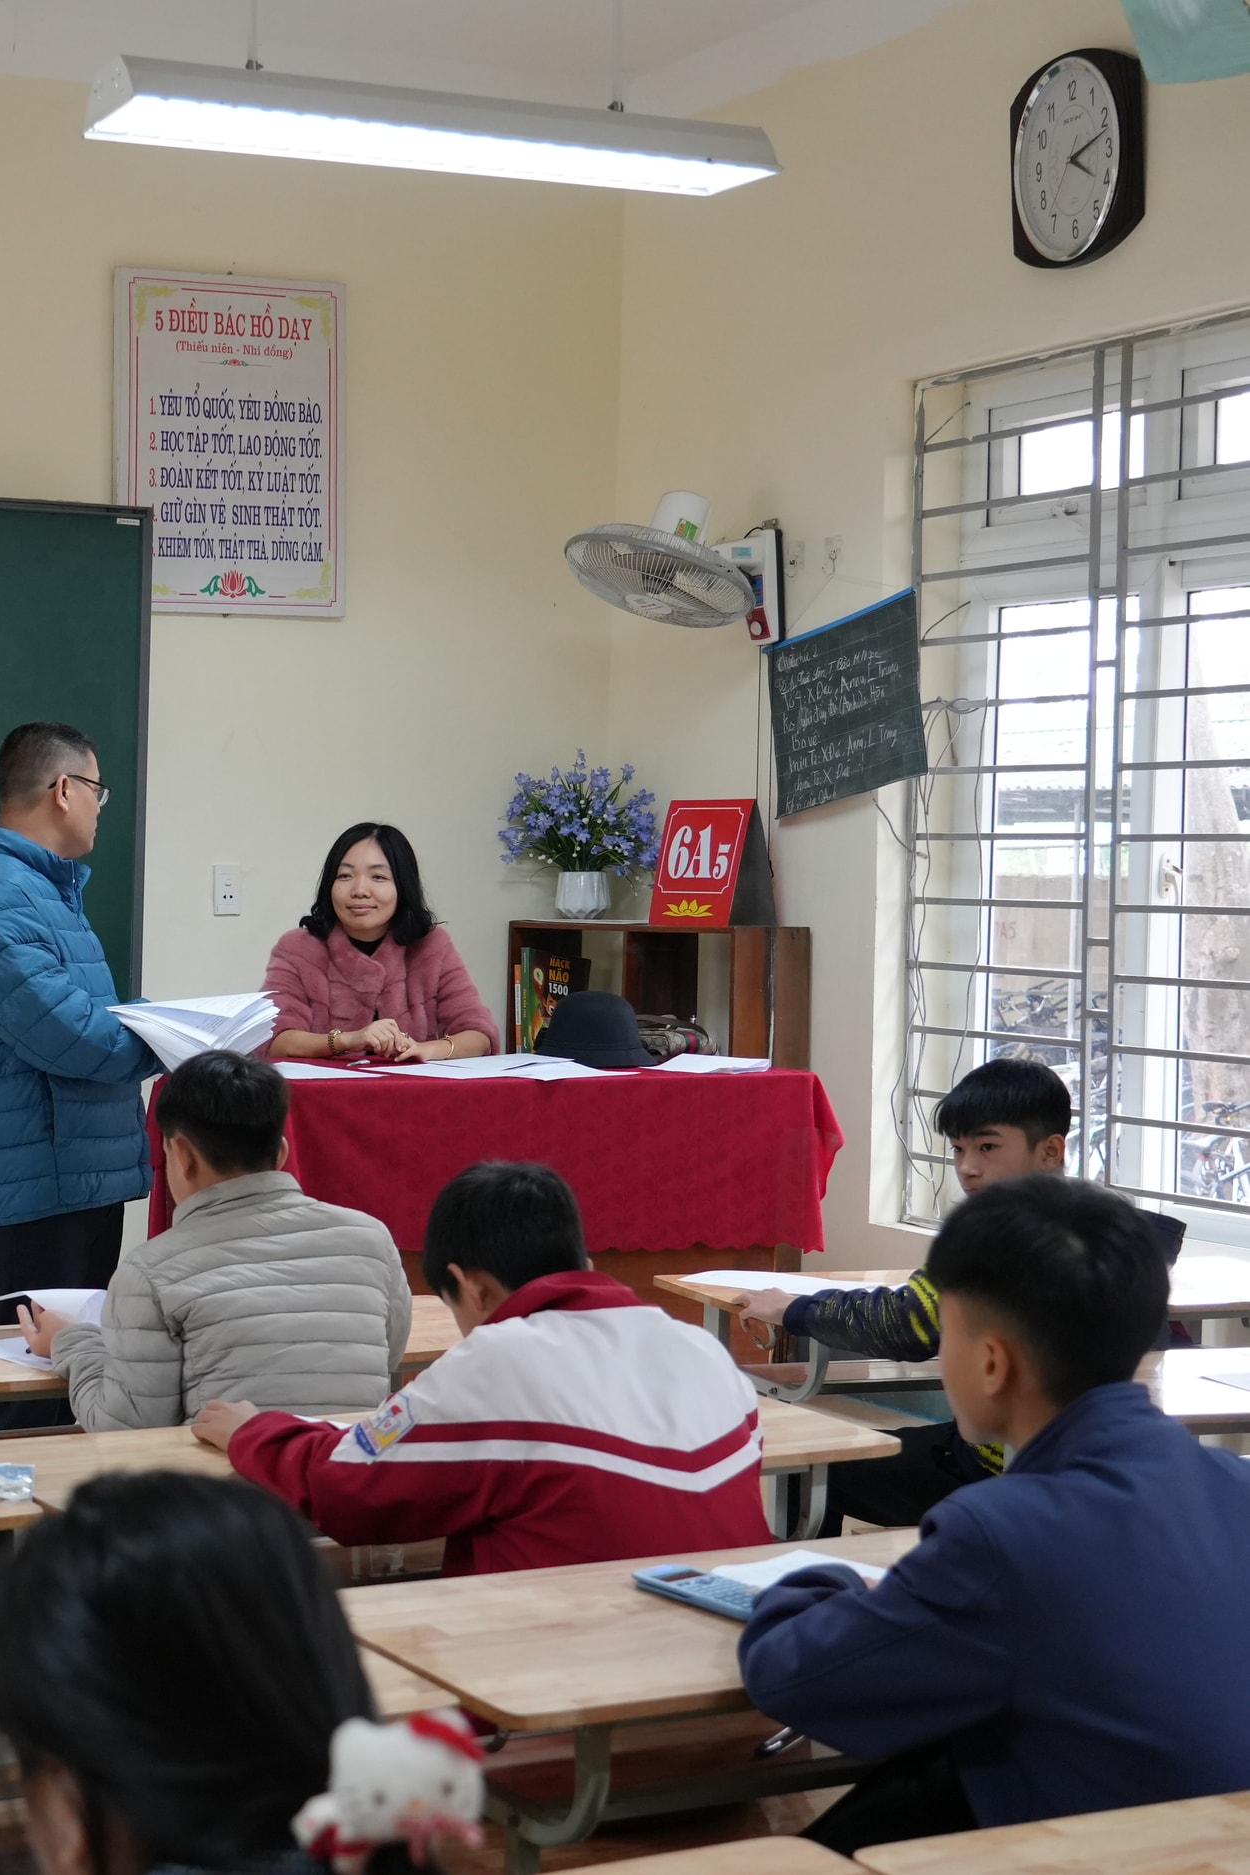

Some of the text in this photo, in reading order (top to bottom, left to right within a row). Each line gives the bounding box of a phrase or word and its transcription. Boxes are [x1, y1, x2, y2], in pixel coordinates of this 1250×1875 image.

[1067, 80, 1077, 101] 12
[1089, 87, 1095, 107] 1
[1047, 102, 1055, 122] 11
[1101, 107, 1109, 129] 2
[1037, 129, 1047, 150] 10
[1105, 137, 1113, 158] 3
[1035, 162, 1042, 182] 9
[1103, 168, 1110, 186] 4
[1040, 190, 1047, 210] 8
[1093, 200, 1100, 221] 5
[1051, 214, 1057, 234] 7
[1072, 219, 1079, 240] 6
[155, 297, 312, 347] 5 ĐIỀU BÁC HỒ DẠY
[175, 340, 208, 352] (Thiếu
[211, 343, 233, 354] niên
[243, 345, 261, 356] Nhi
[150, 382, 323, 424] 1. YÊU TỔ QUỐC, YÊU ĐỒNG BÀO.
[150, 423, 323, 462] 2. HỌC TẬP TỐT, LAO ĐỘNG TỐT.
[149, 458, 322, 498] 3. ĐOÀN KẾT TỐT, KỶ LUẬT TỐT.
[160, 497, 183, 523] GIỮ
[185, 497, 206, 523] GÌN
[210, 497, 226, 531] VỆ
[232, 504, 261, 526] SINH
[264, 500, 295, 532] THẬT
[298, 497, 322, 528] TỐT.
[158, 530, 192, 558] KHIÊM
[194, 528, 216, 562] TỐN,
[218, 532, 245, 565] THẬT
[247, 534, 269, 564] THÀ,
[301, 531, 324, 562] CẢM.
[667, 824, 732, 880] 6A5
[549, 957, 570, 969] HACK
[548, 968, 570, 983] NÃO
[548, 982, 569, 996] 1500
